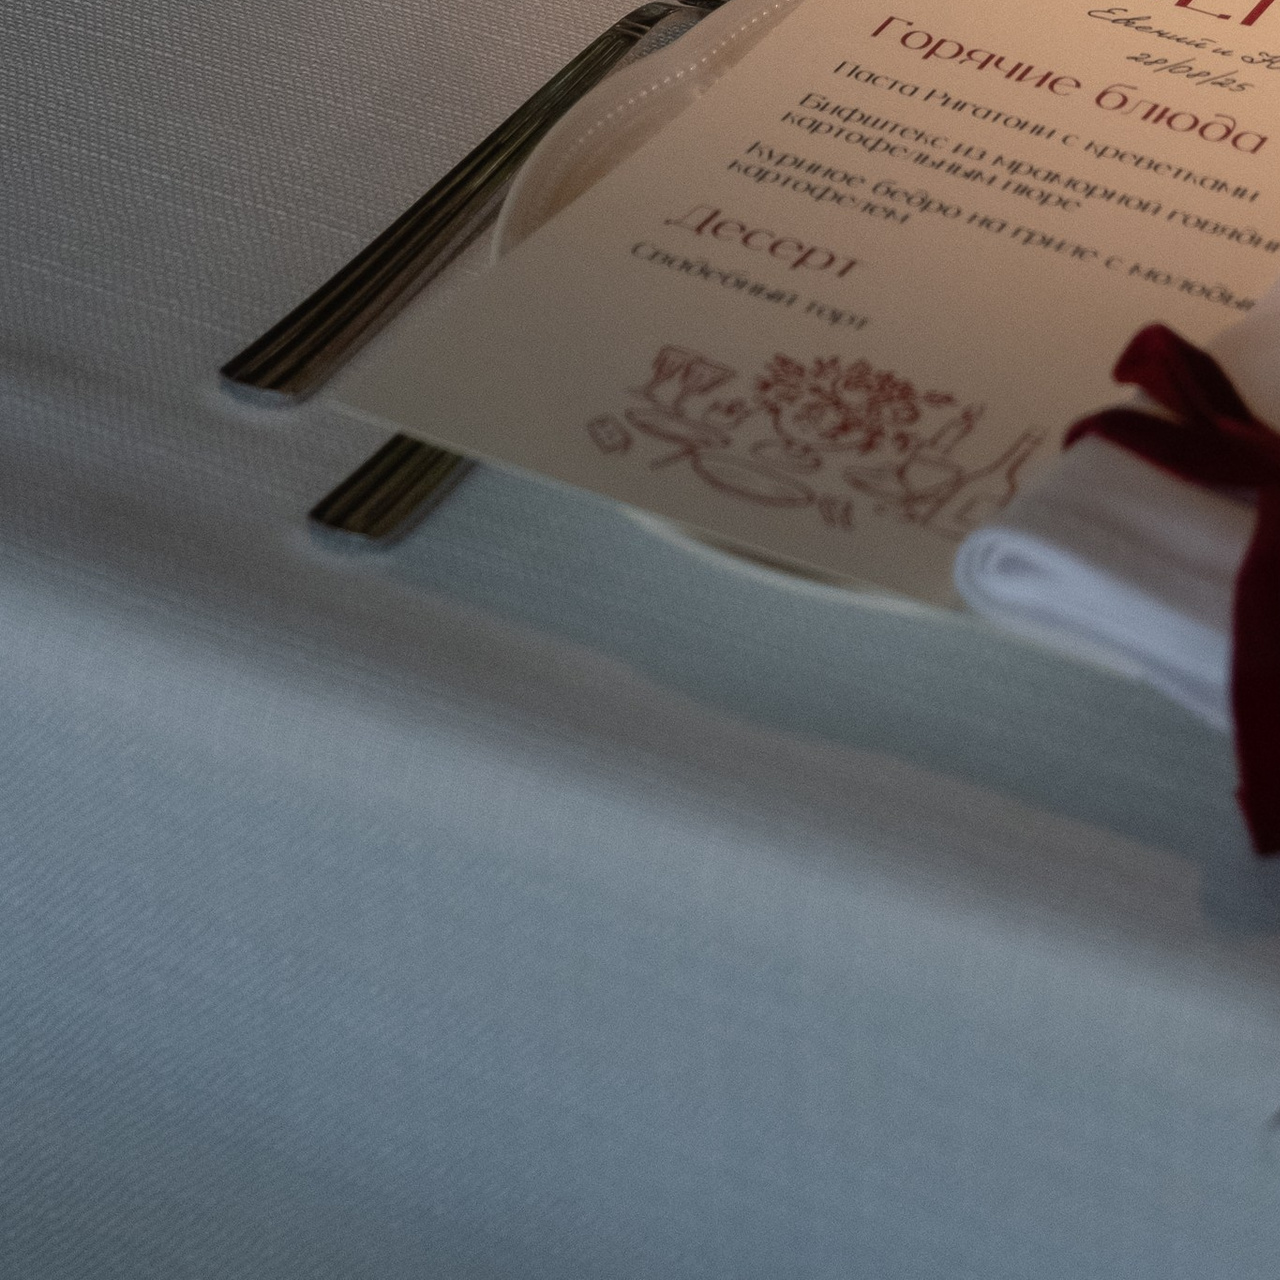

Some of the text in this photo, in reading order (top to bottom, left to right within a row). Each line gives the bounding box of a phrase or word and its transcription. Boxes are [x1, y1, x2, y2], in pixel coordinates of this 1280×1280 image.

[832, 59, 1260, 204] Паста Ригатони с креветками
[871, 15, 1269, 155] Горячие блюда
[1126, 53, 1254, 92] 28/08/25
[745, 140, 866, 188] Куриное
[871, 179, 962, 219] бедро
[1104, 254, 1124, 270] с
[798, 92, 949, 149] Бифштекс
[951, 142, 987, 162] из
[992, 154, 1163, 217] мраморной
[664, 203, 858, 278] Десерт
